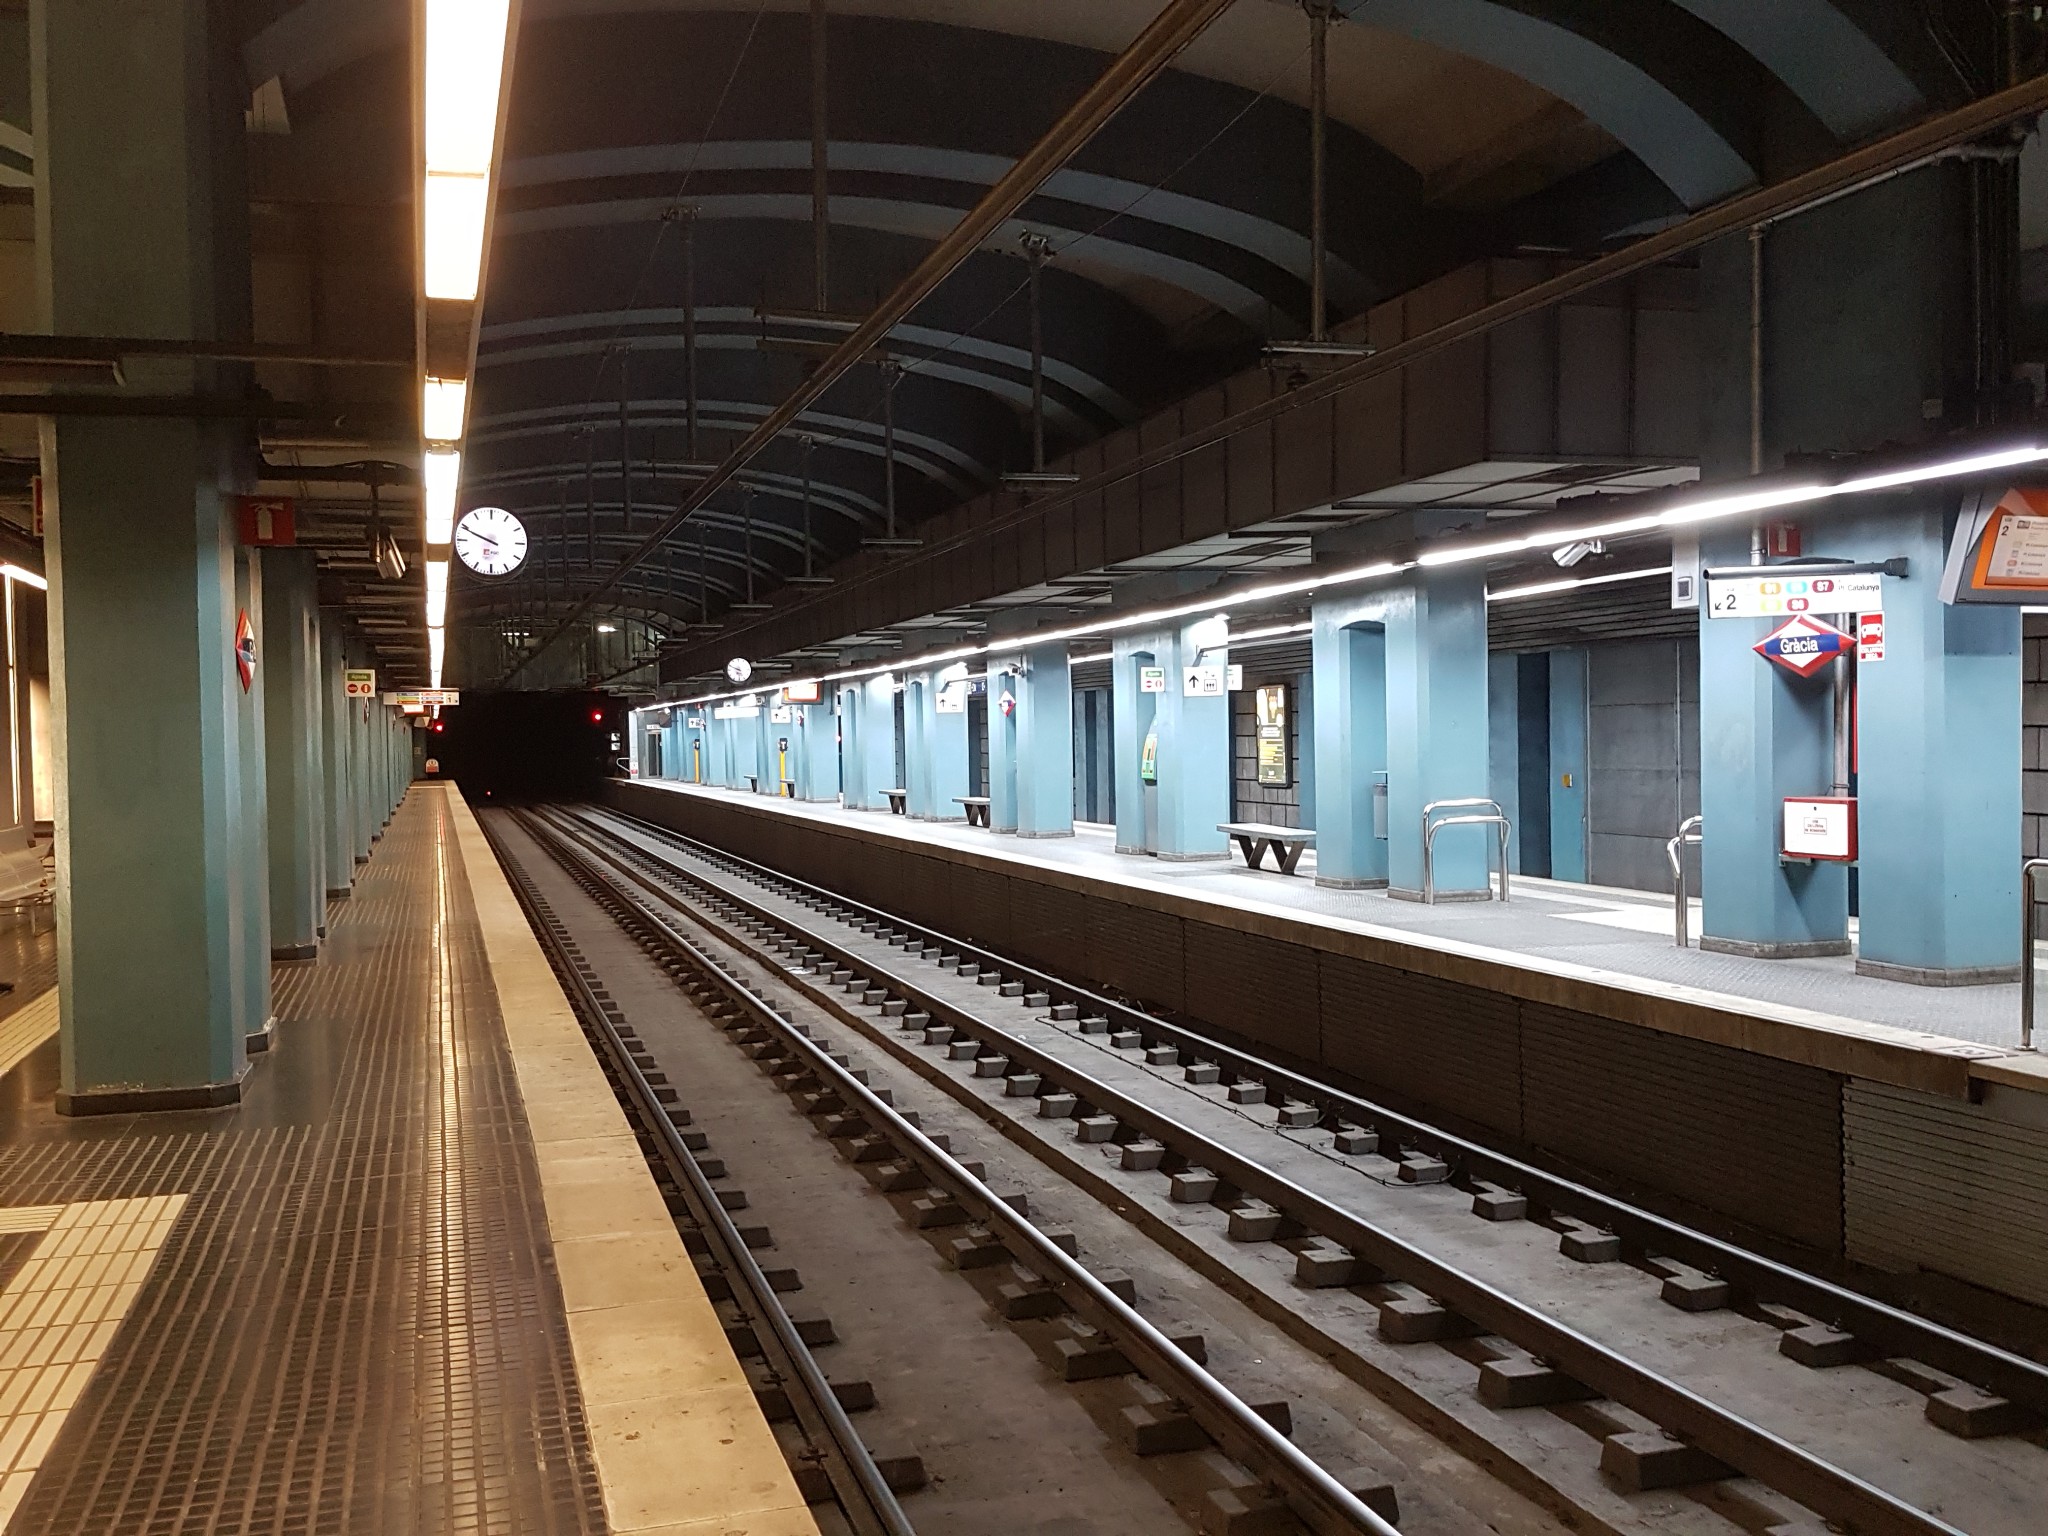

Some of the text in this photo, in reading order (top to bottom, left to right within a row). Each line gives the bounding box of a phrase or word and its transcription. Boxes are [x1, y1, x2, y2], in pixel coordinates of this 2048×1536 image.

[2001, 525, 2009, 536] 2
[1847, 584, 1879, 592] Catalunya
[1726, 594, 1737, 610] 2
[1780, 637, 1819, 653] Gràcia
